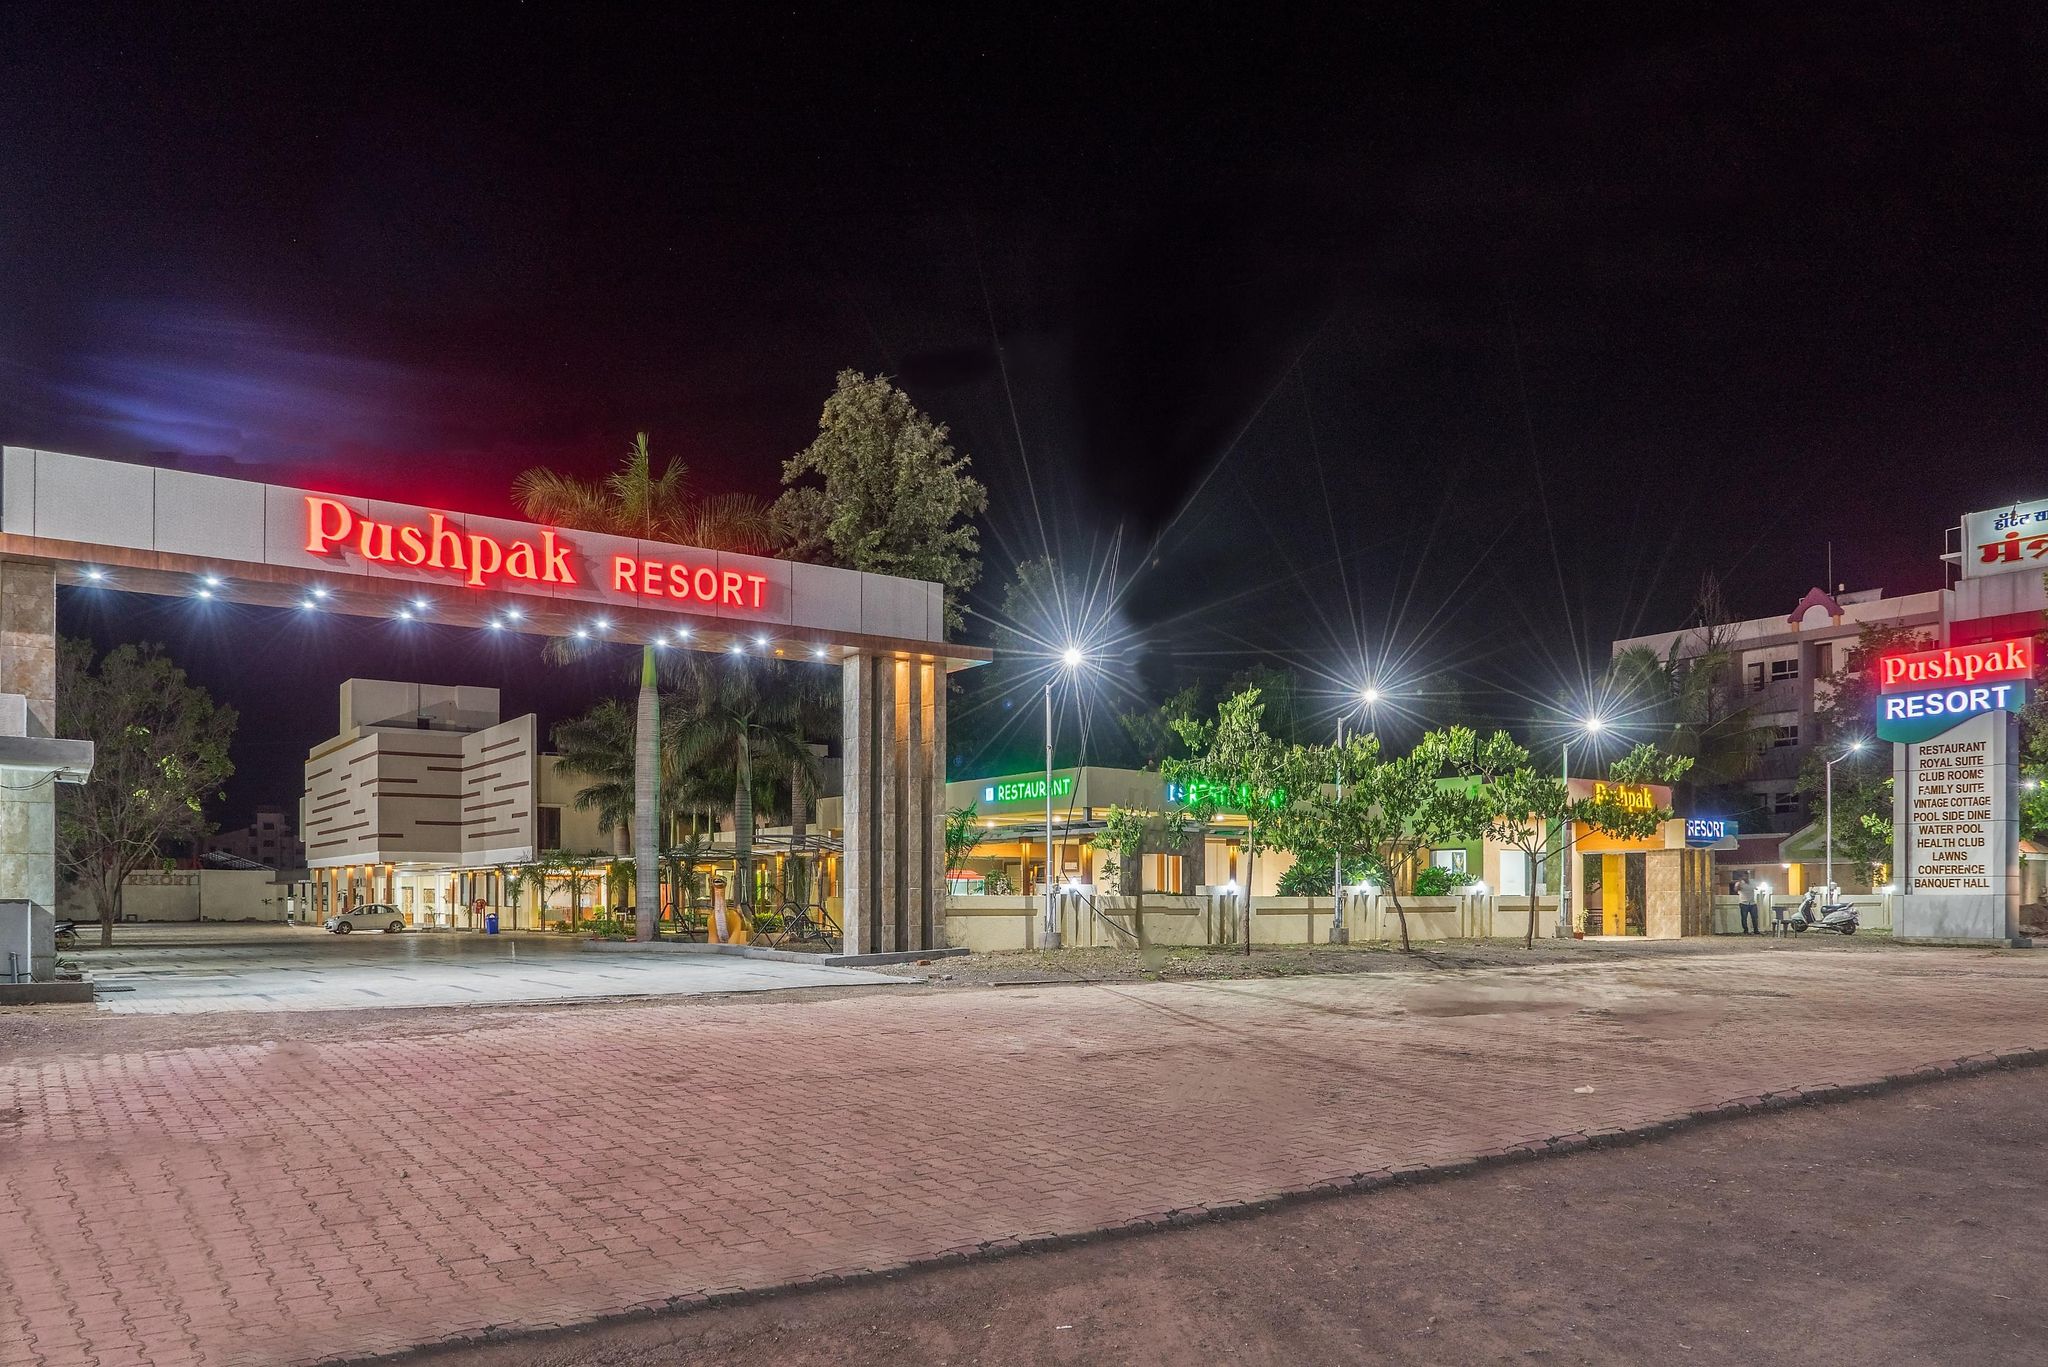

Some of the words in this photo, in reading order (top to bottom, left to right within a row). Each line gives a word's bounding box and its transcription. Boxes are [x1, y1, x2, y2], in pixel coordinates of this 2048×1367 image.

[304, 495, 577, 587] Pushpak
[613, 555, 767, 608] RESORT
[1885, 643, 2026, 684] Pushpak
[1887, 686, 2011, 719] RESORT
[1919, 741, 1986, 755] RESTAURANT
[1920, 759, 1952, 769] ROYAL
[1955, 756, 1984, 766] SUITE
[1919, 771, 1945, 782] CLUB
[1947, 769, 1984, 780] ROOMS
[1918, 785, 1954, 795] FAMILY
[1956, 782, 1984, 793] SUITE
[1595, 783, 1652, 812] Phpak
[1913, 798, 1949, 809] VINTAGE
[1950, 796, 1991, 807] COTTAGE
[1914, 812, 1940, 821] POOL
[1942, 811, 1965, 821] SIDE
[1967, 810, 1991, 820] DINE
[1688, 820, 1725, 837] RESORT
[1918, 825, 1954, 835] WATER
[1956, 823, 1984, 834] POOL
[1917, 838, 1955, 848] HEALTH
[1958, 837, 1985, 848] CLUB
[1932, 851, 1968, 861] LAWNS
[1918, 865, 1985, 874] CONFERENCE
[1914, 879, 1961, 889] BANQUET
[1963, 879, 1990, 888] HALL
